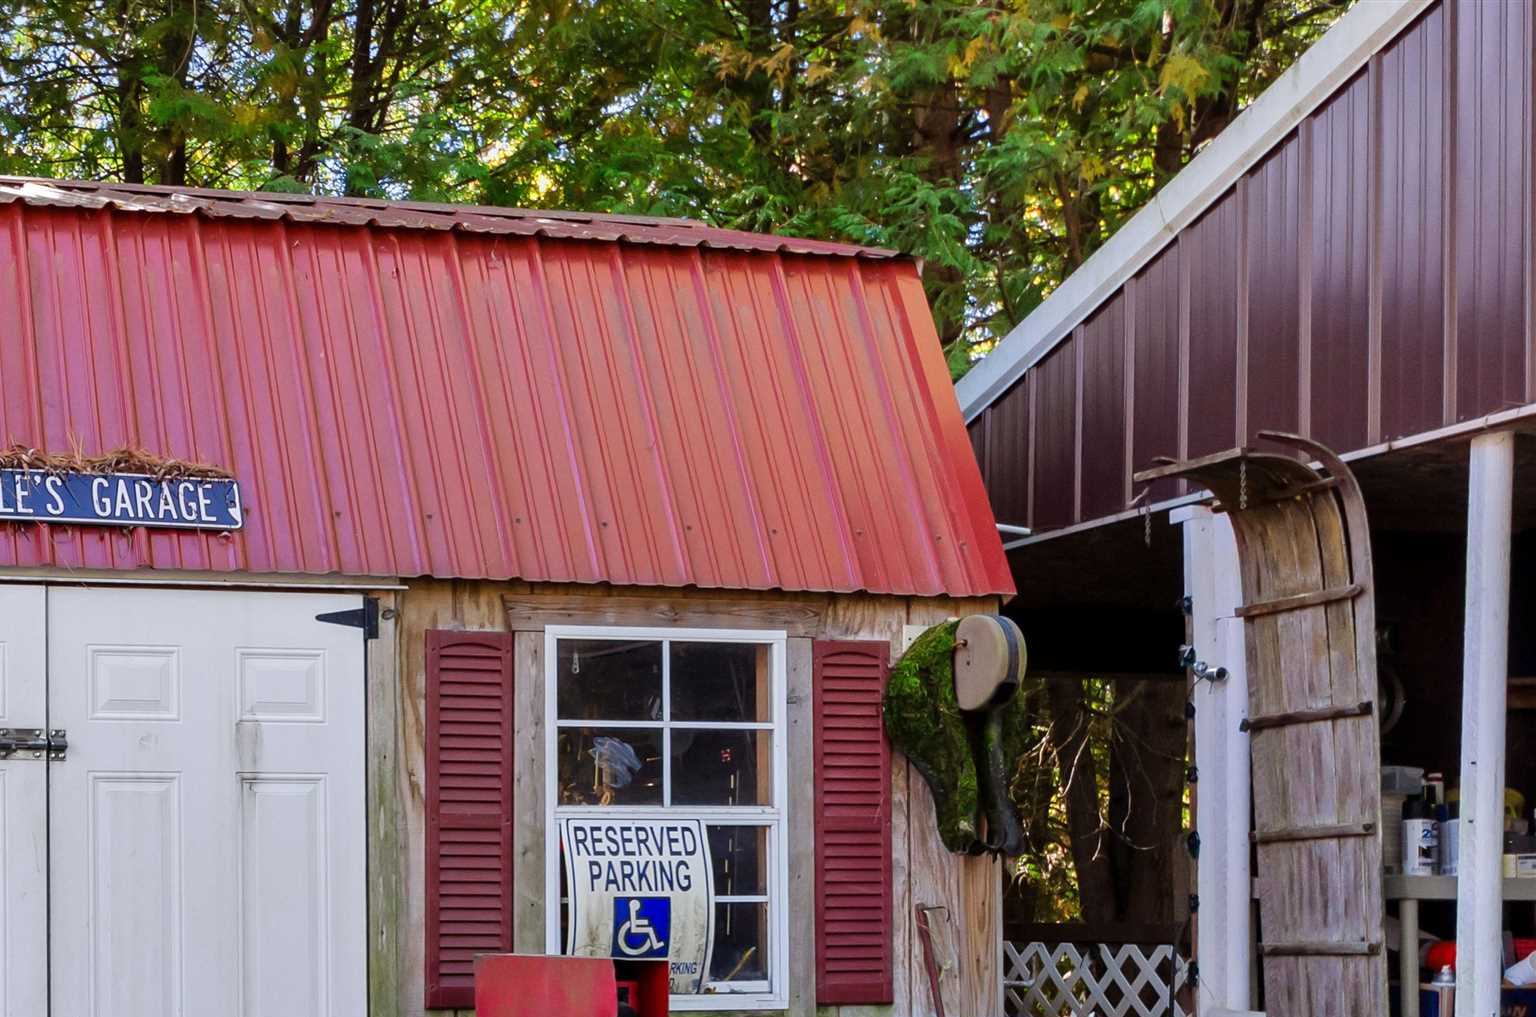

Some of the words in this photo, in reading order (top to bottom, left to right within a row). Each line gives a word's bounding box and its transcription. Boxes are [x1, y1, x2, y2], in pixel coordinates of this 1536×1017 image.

[93, 477, 216, 521] GARAGE
[574, 826, 697, 856] RESERVED
[589, 860, 692, 892] PARKING
[670, 962, 697, 975] RKING
